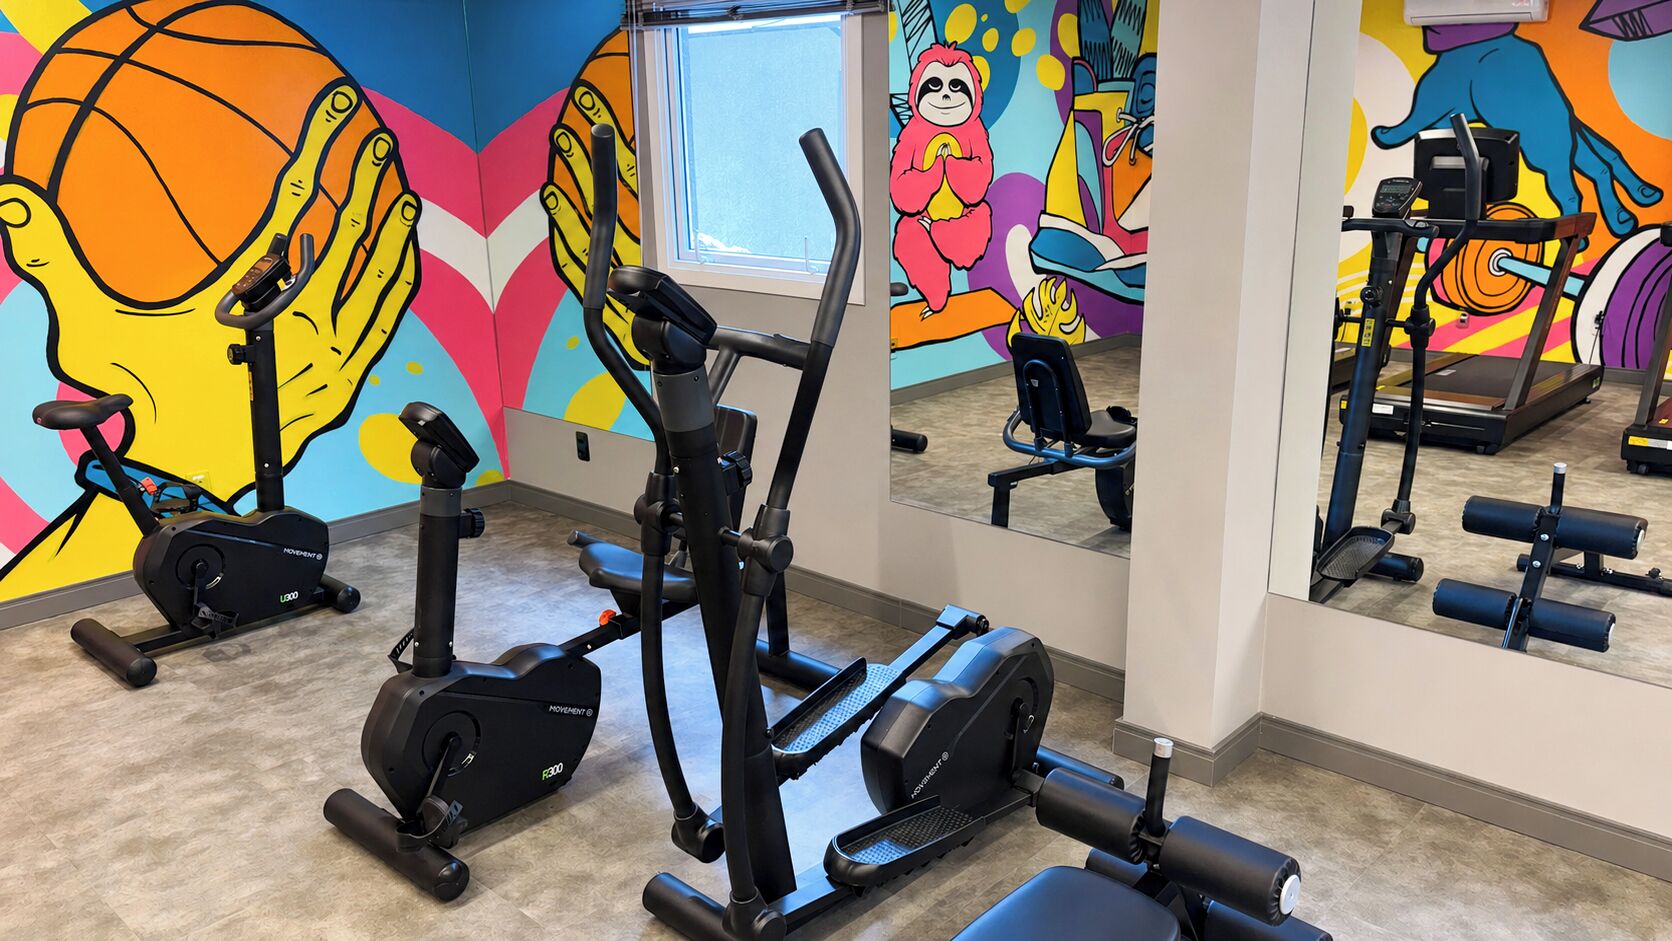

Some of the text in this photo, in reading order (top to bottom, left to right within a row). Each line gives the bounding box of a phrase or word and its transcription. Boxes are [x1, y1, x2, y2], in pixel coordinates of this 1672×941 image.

[283, 547, 316, 558] MOVEMENT
[280, 591, 299, 603] U300
[549, 705, 586, 716] MOVEMENT
[542, 762, 564, 781] R300
[911, 758, 942, 799] MOVEMENT
